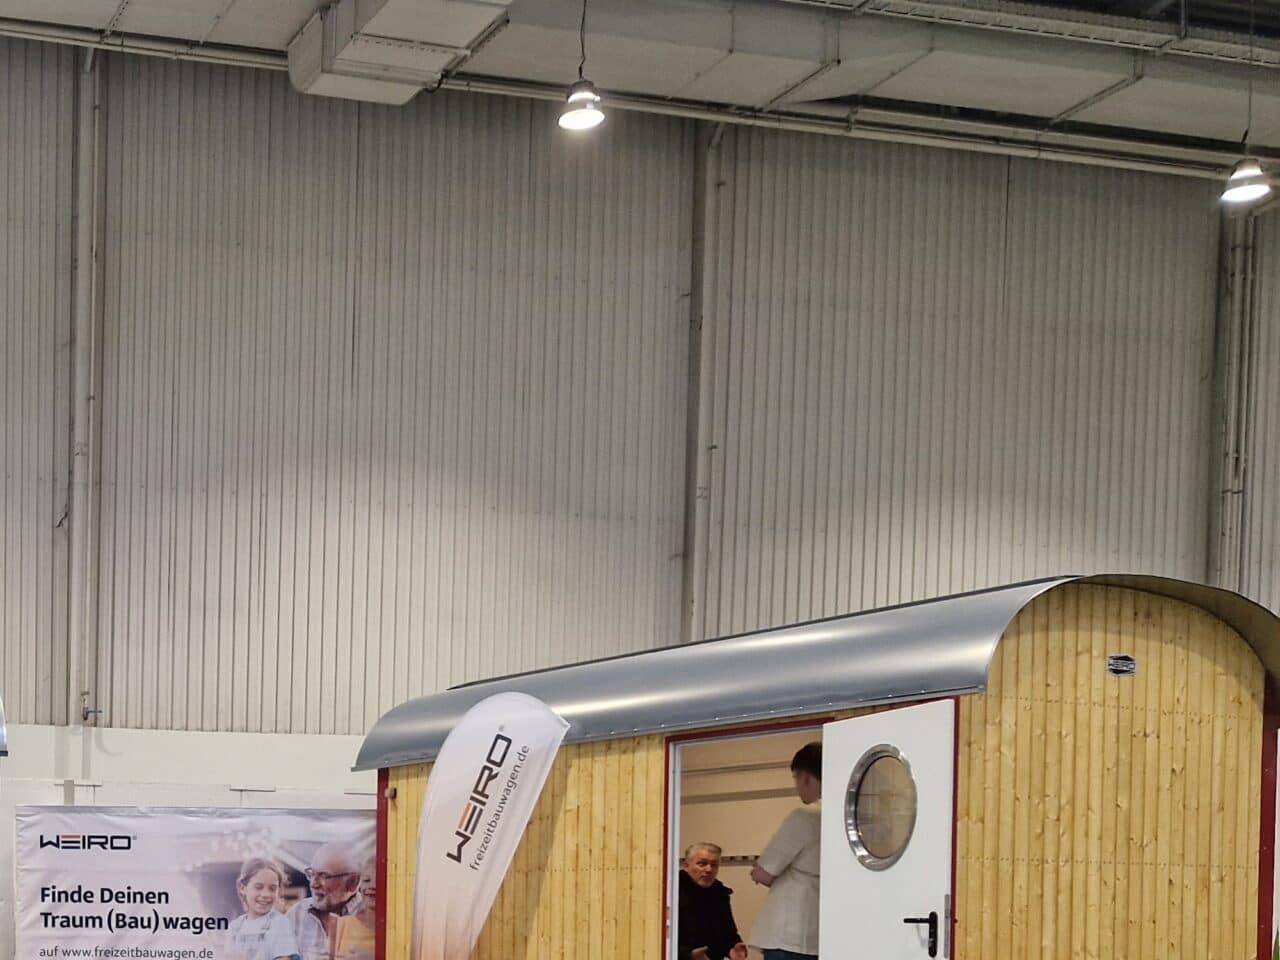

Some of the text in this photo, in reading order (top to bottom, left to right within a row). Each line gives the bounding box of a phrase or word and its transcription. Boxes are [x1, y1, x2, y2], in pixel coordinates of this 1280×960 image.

[447, 733, 512, 863] WEIRO
[470, 745, 530, 871] freizeitbauwagen.de
[39, 834, 132, 850] WEIRO
[40, 885, 170, 905] Finde Deinen
[40, 908, 229, 935] Traum (Bau) wagen
[39, 946, 214, 960] auf www.freizeitbauwagen.de
